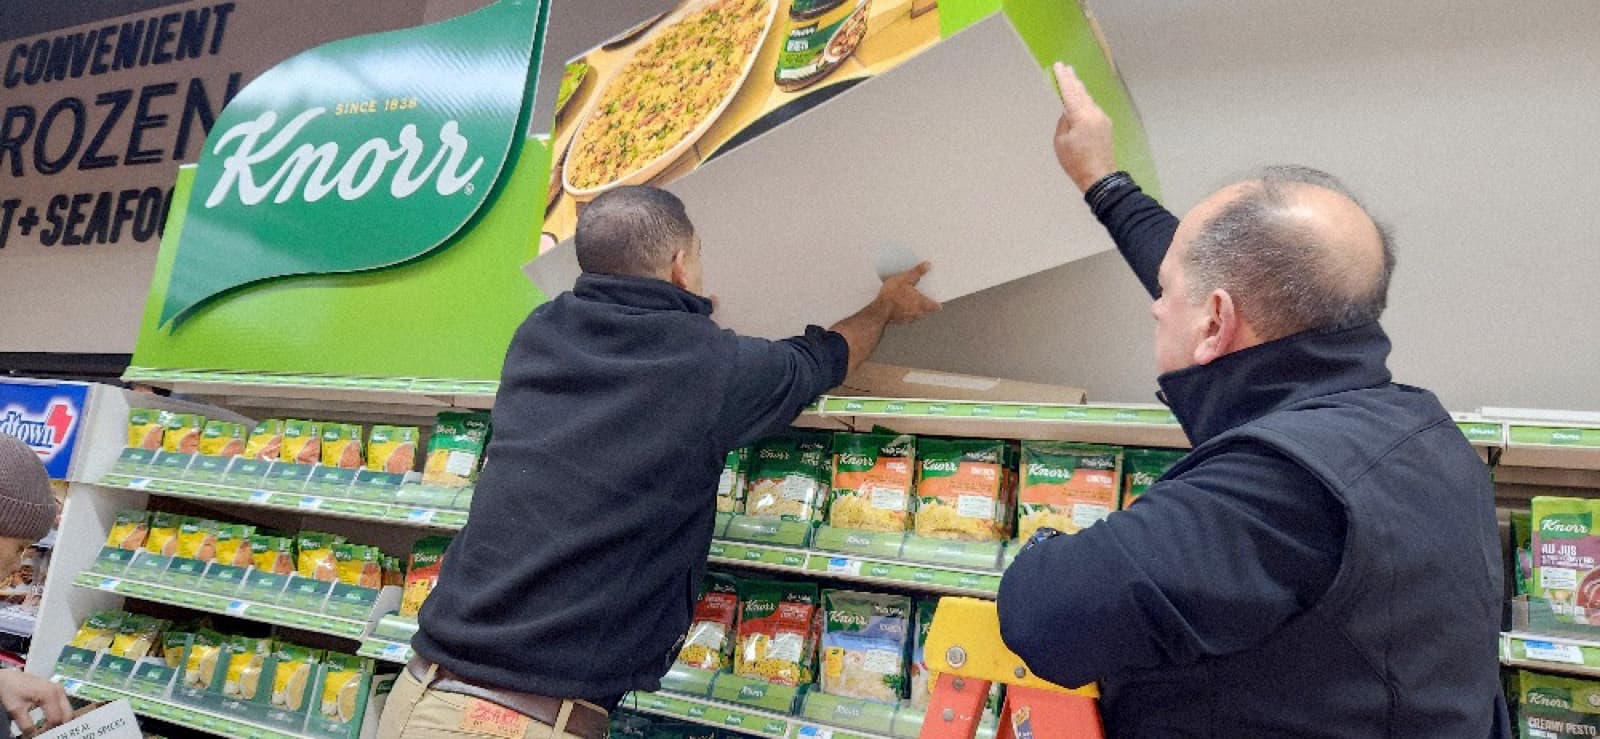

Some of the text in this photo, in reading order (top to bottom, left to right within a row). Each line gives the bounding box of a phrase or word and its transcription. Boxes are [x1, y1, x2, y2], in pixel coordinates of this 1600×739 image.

[4, 3, 235, 88] CONVENIENT
[335, 102, 377, 116] SINCE
[205, 107, 484, 208] Knorr
[839, 452, 874, 466] Knorr
[922, 459, 957, 472] Knorr
[1028, 463, 1071, 479] Knorr
[1541, 519, 1588, 534] Knorr
[829, 610, 867, 625] Knorr
[1528, 692, 1570, 709] Knorr
[1566, 722, 1596, 736] PESTO
